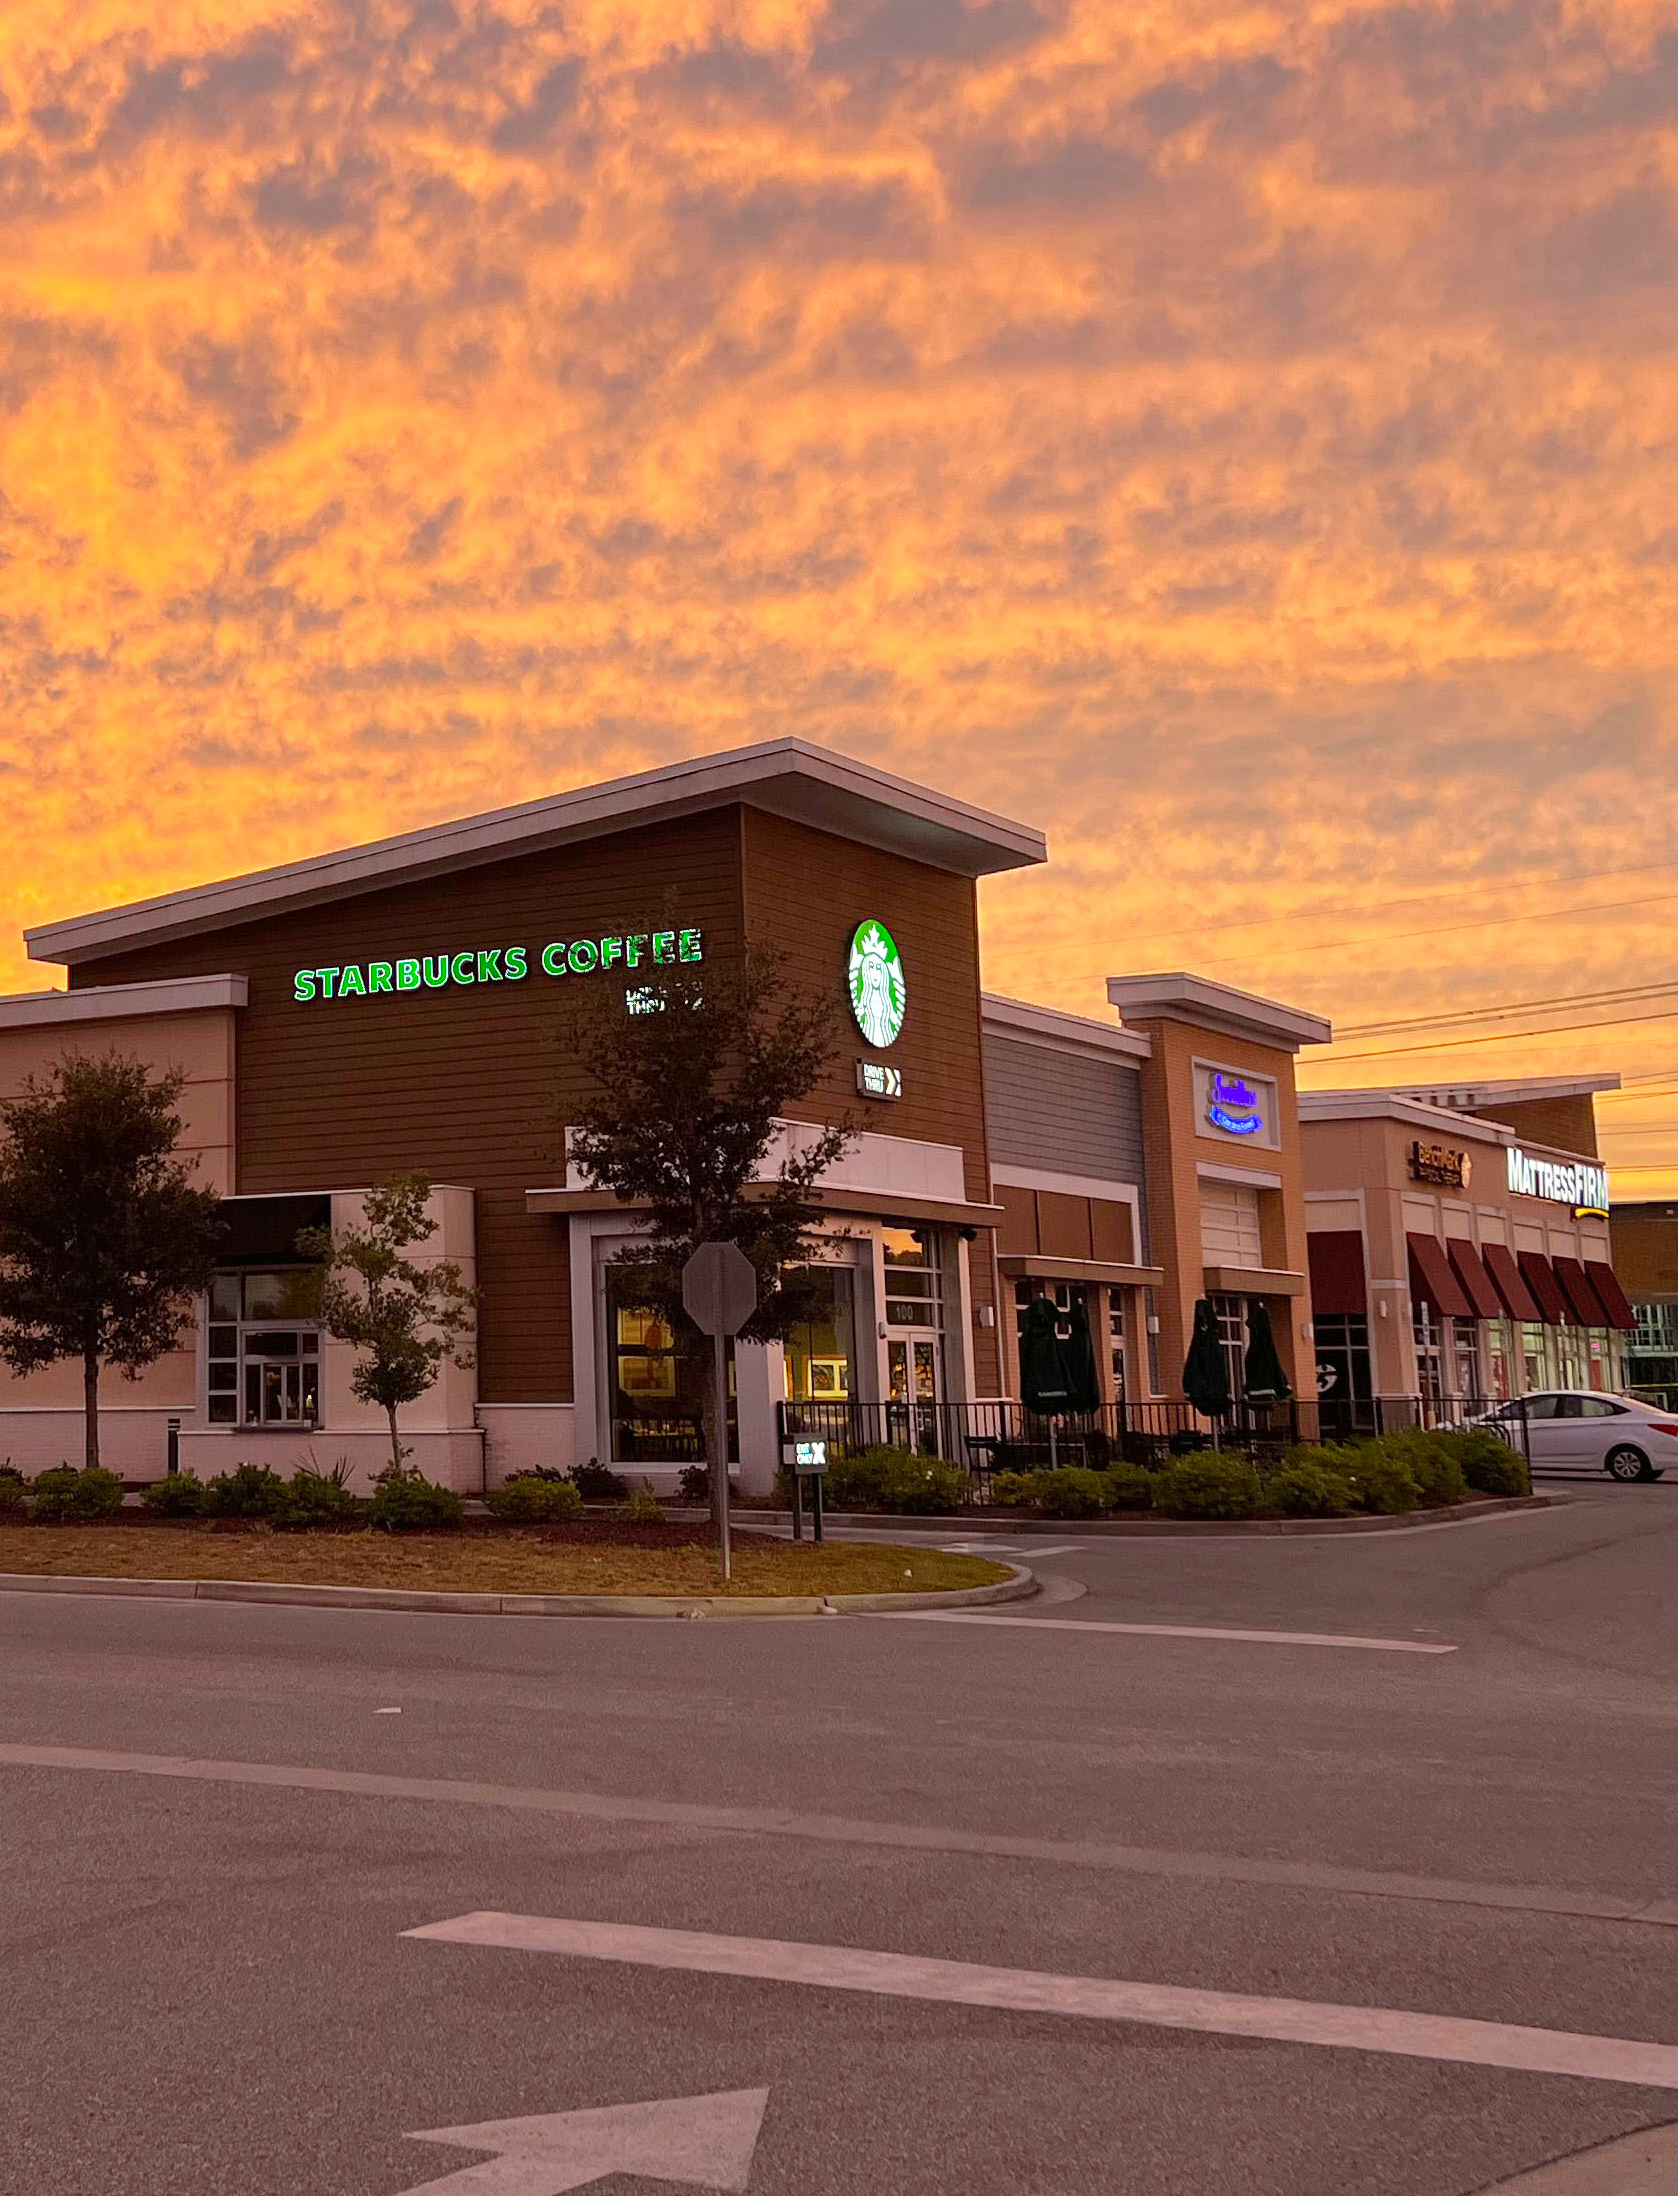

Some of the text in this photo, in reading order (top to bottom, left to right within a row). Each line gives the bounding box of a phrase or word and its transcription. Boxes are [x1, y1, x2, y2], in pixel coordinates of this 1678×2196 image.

[293, 929, 703, 1001] STARBUCKS COFFEE
[863, 1063, 885, 1080] DRIVE
[864, 1077, 884, 1093] THRU
[895, 1304, 914, 1321] 100
